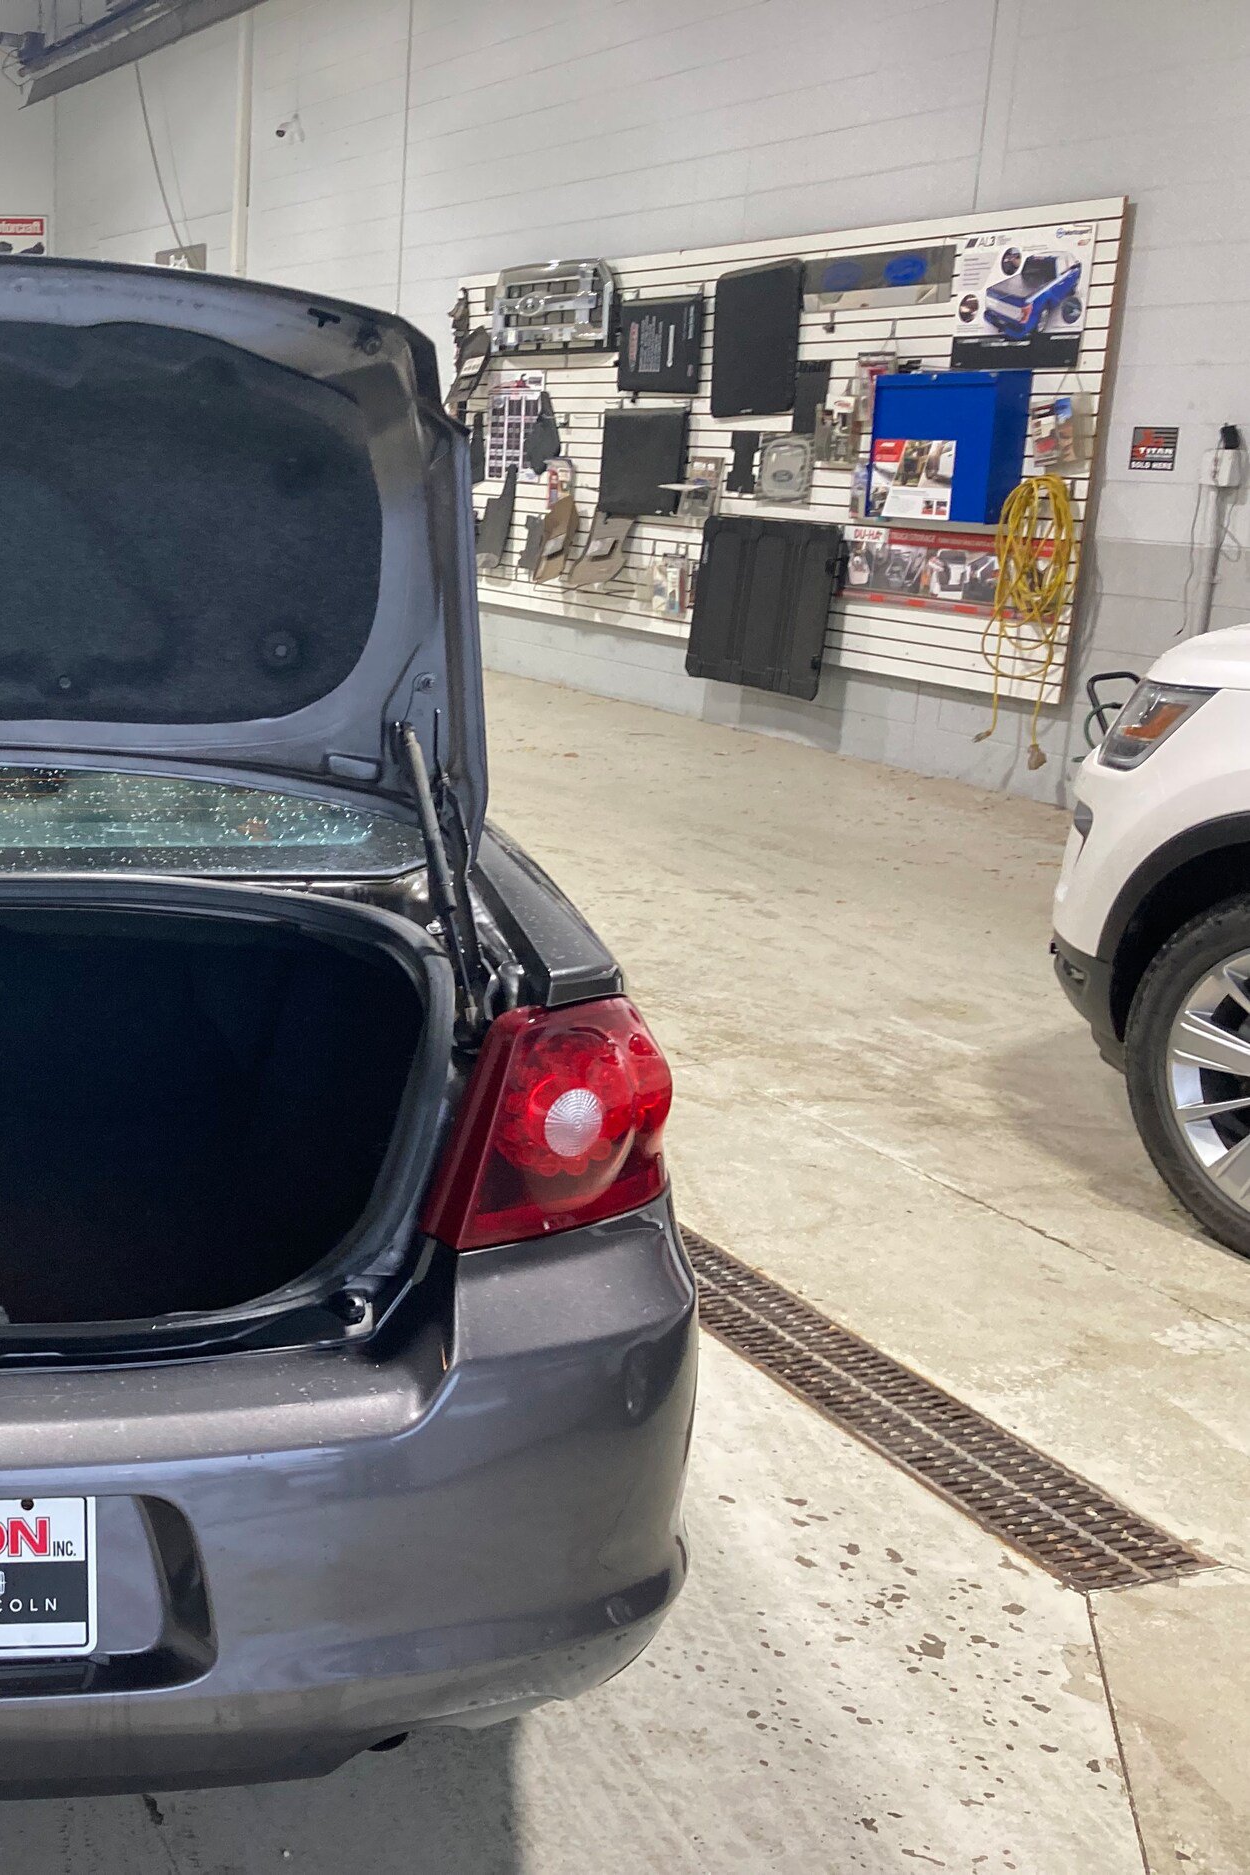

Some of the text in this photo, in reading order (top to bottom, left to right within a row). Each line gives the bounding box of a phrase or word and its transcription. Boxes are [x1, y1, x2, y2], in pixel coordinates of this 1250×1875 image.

[1138, 447, 1174, 455] TITAN
[1131, 461, 1151, 469] SOLD
[53, 1540, 77, 1557] INC.
